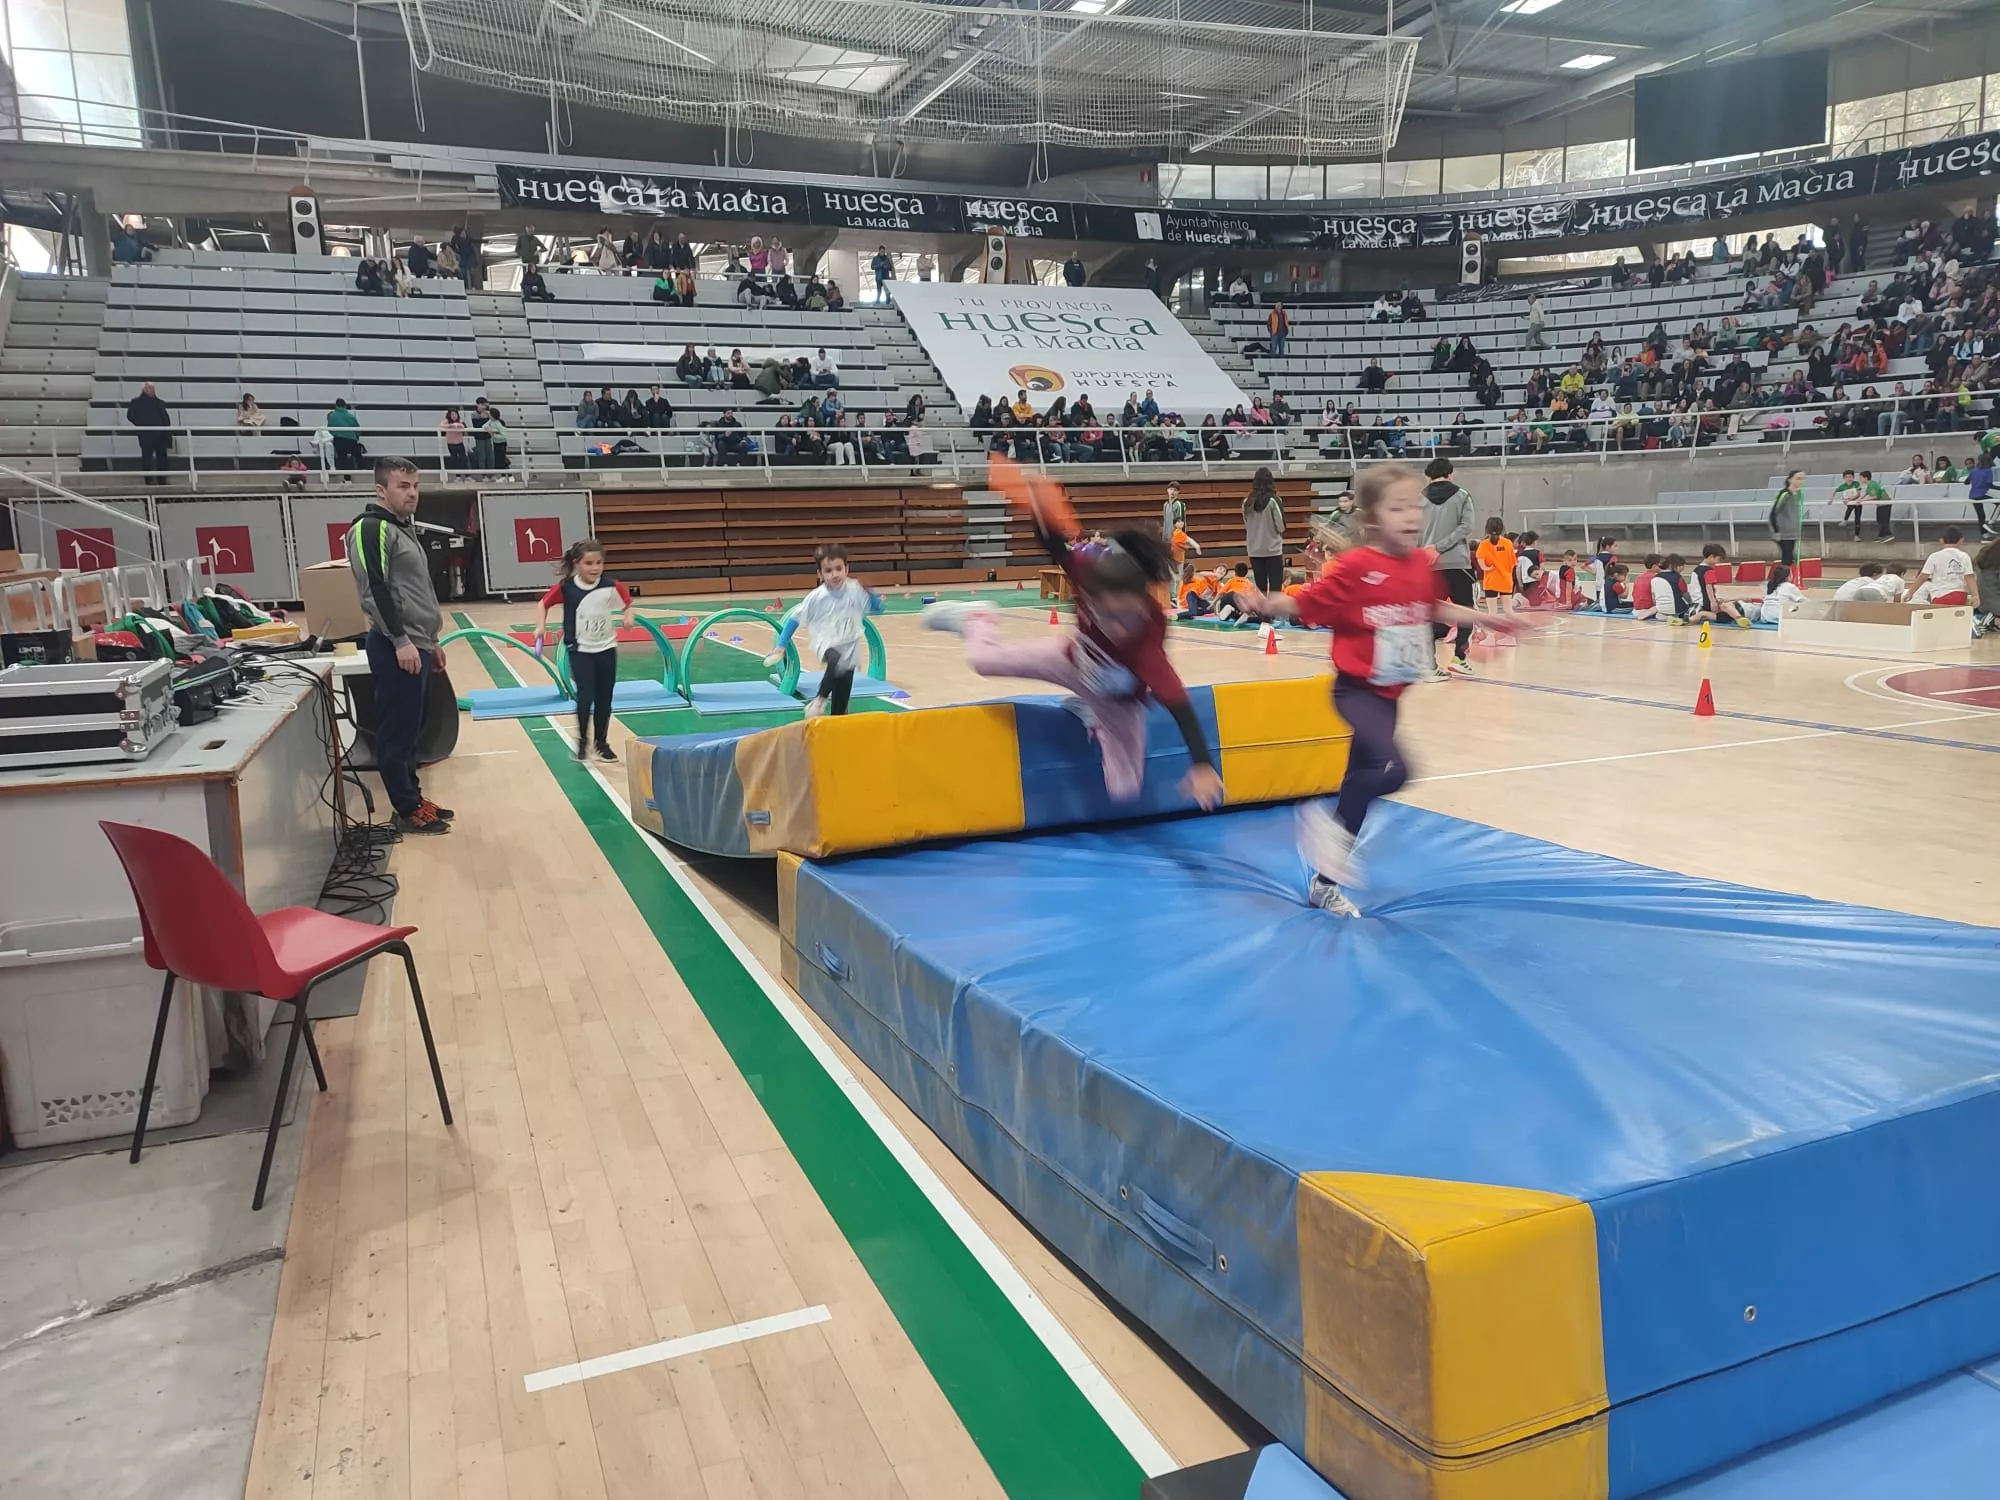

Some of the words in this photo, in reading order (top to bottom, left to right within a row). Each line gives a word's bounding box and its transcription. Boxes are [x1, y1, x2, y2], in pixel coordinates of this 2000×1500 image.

[823, 192, 925, 215] Huesca
[1166, 214, 1249, 231] Ayuntamiento
[1167, 231, 1182, 241] de
[1185, 230, 1231, 244] Huesca
[933, 311, 1164, 336] Huesca
